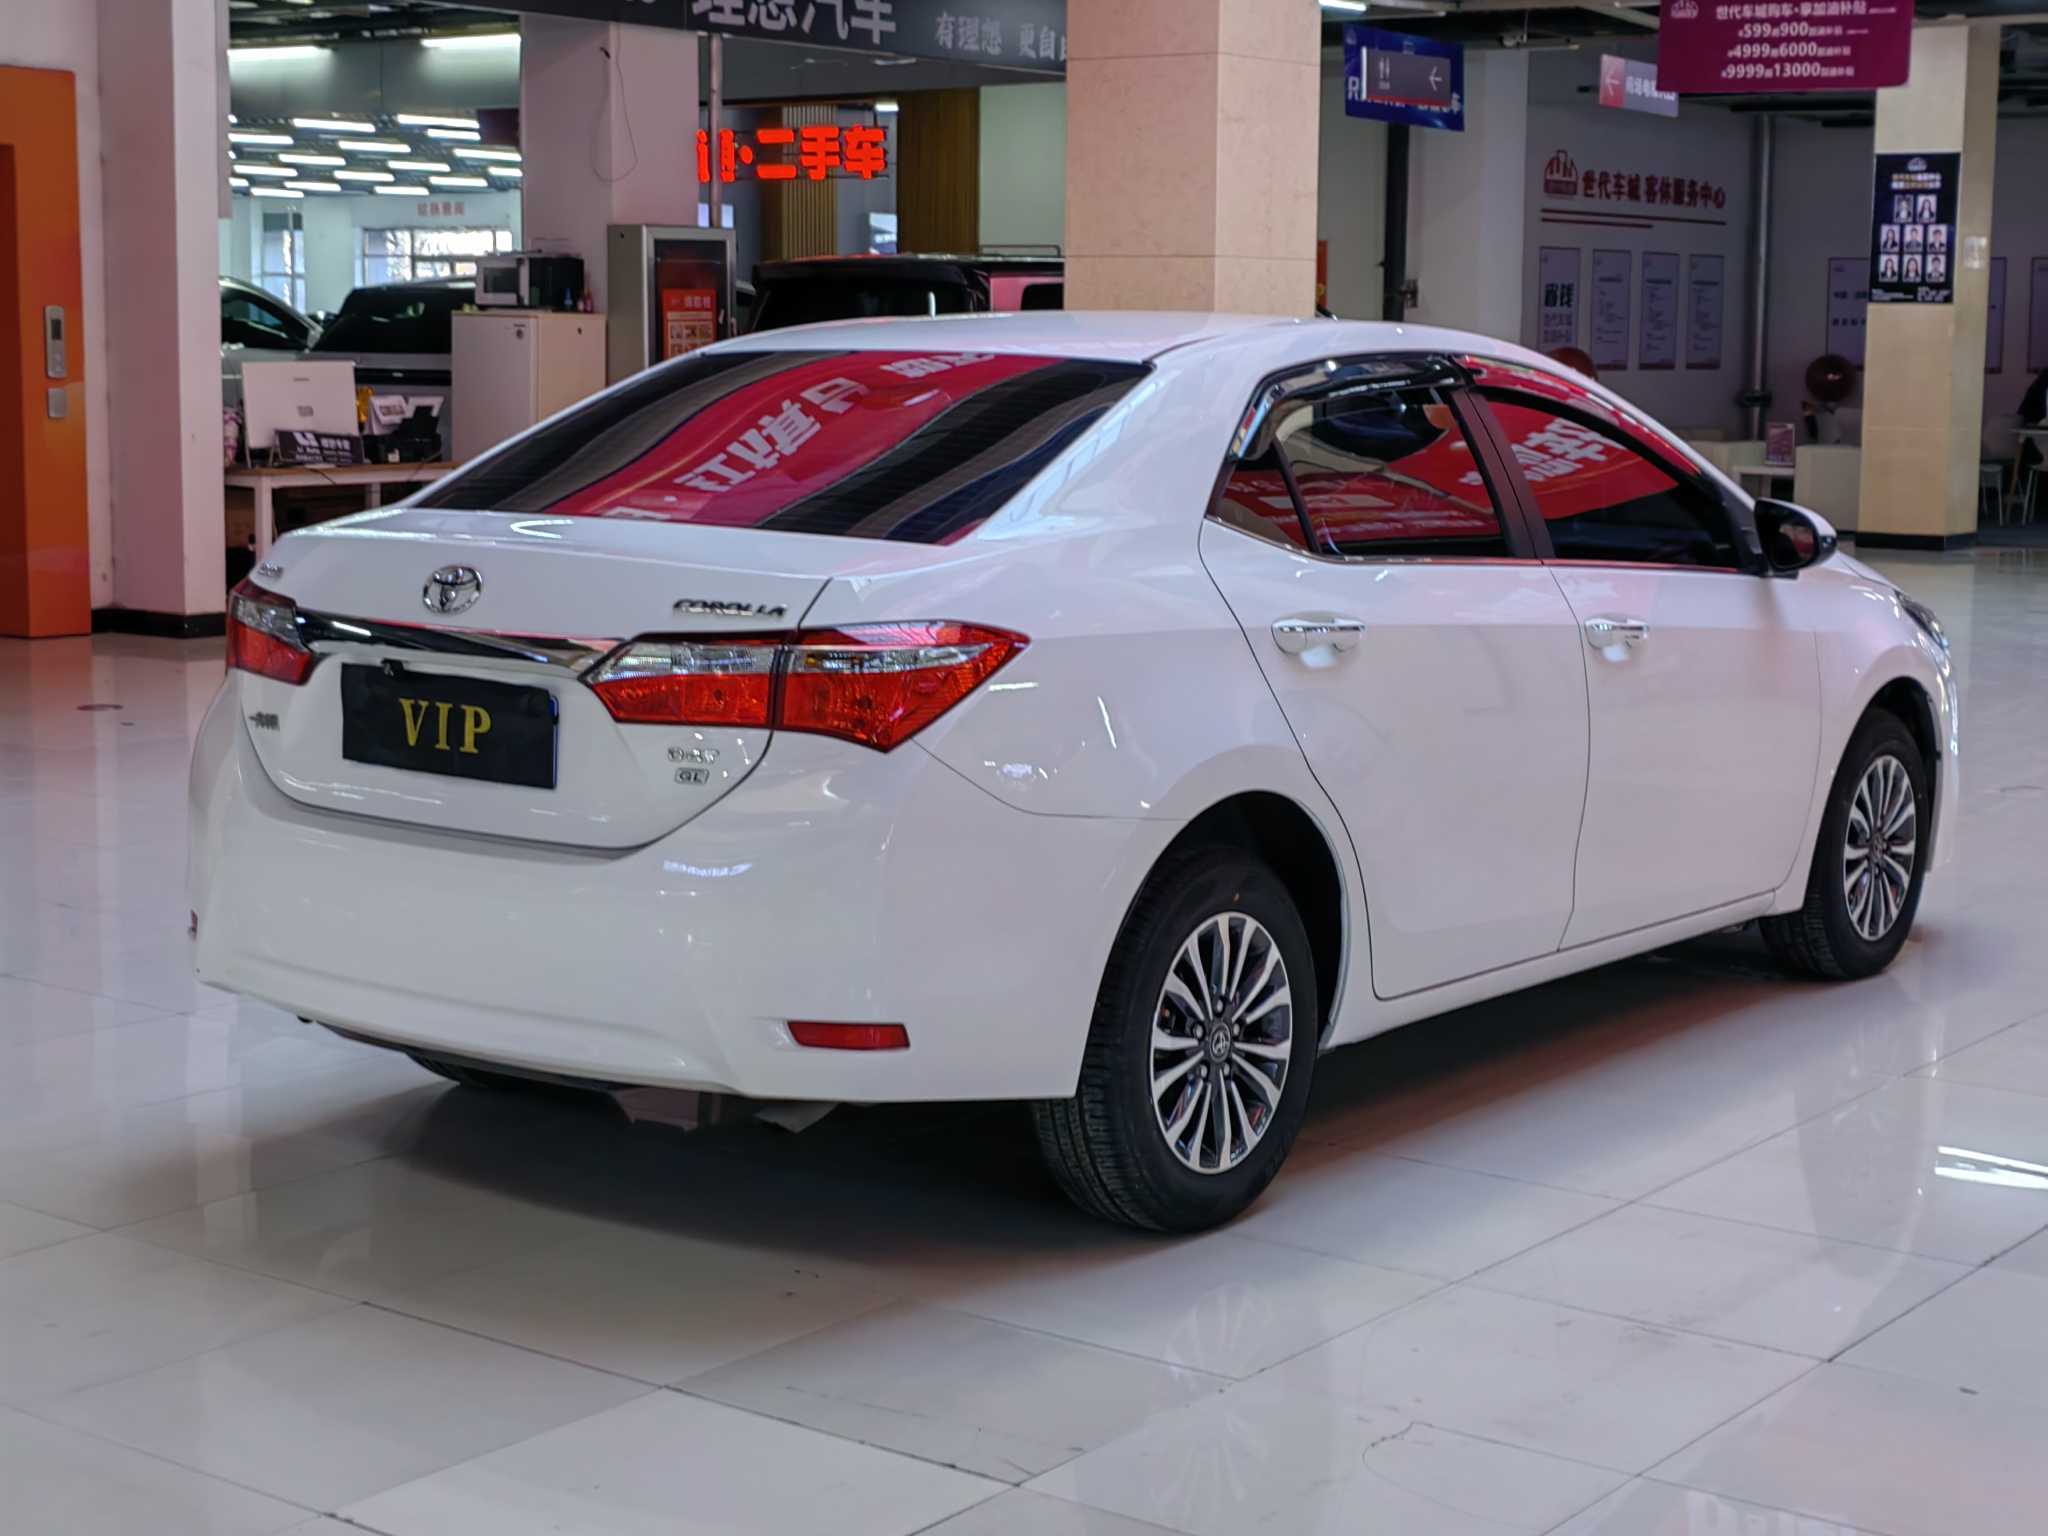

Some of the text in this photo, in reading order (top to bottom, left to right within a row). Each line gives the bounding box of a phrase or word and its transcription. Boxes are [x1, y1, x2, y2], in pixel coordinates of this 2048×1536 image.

[936, 12, 1002, 55] 有理想
[673, 598, 786, 618] COROLLA
[399, 697, 492, 754] VIP
